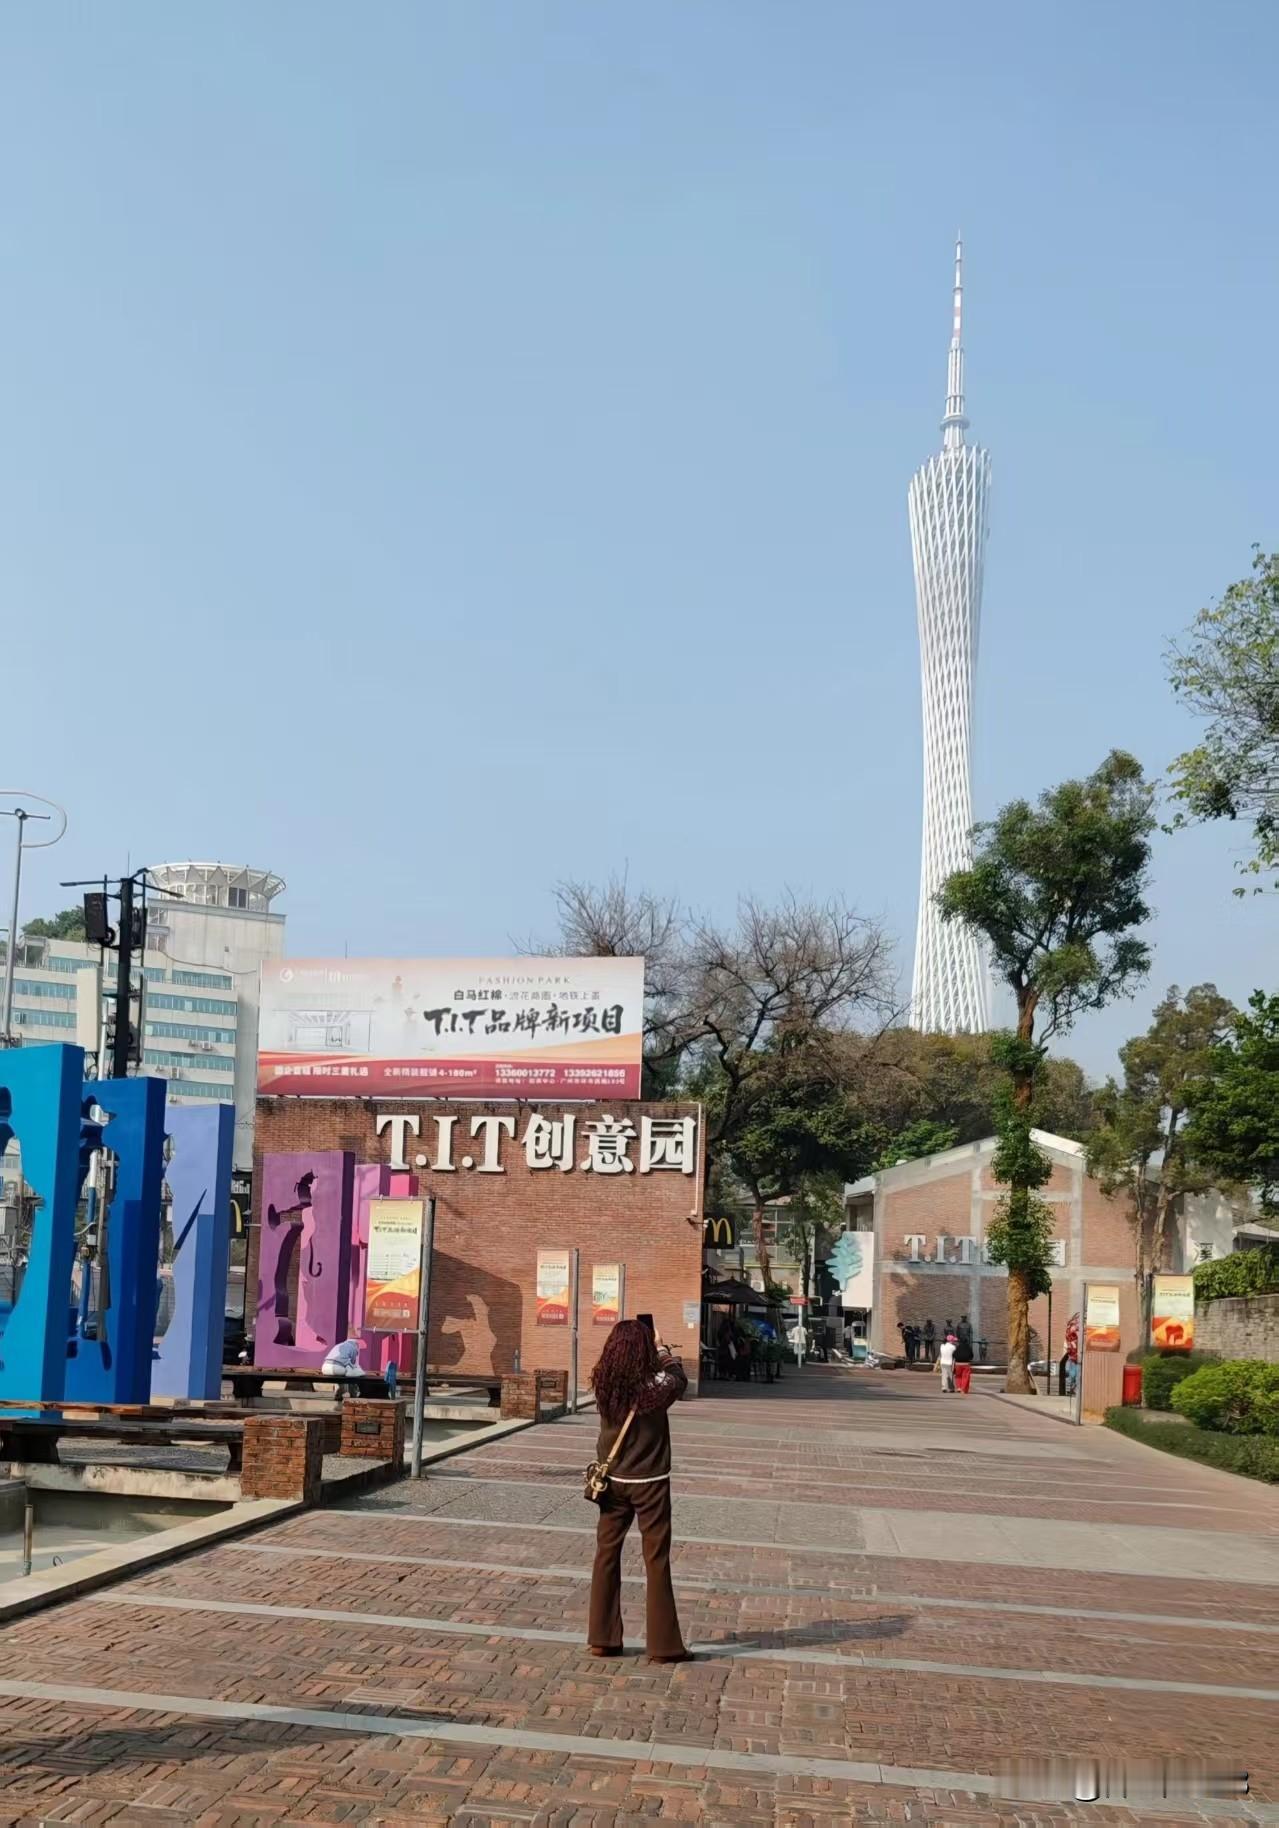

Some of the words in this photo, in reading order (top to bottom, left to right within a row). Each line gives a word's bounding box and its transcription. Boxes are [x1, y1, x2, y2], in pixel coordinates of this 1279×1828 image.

[478, 976, 534, 985] FASHION
[537, 976, 571, 985] PARK
[423, 1003, 624, 1040] T.I.T品牌新项目
[376, 1113, 697, 1175] T.I.T创意园
